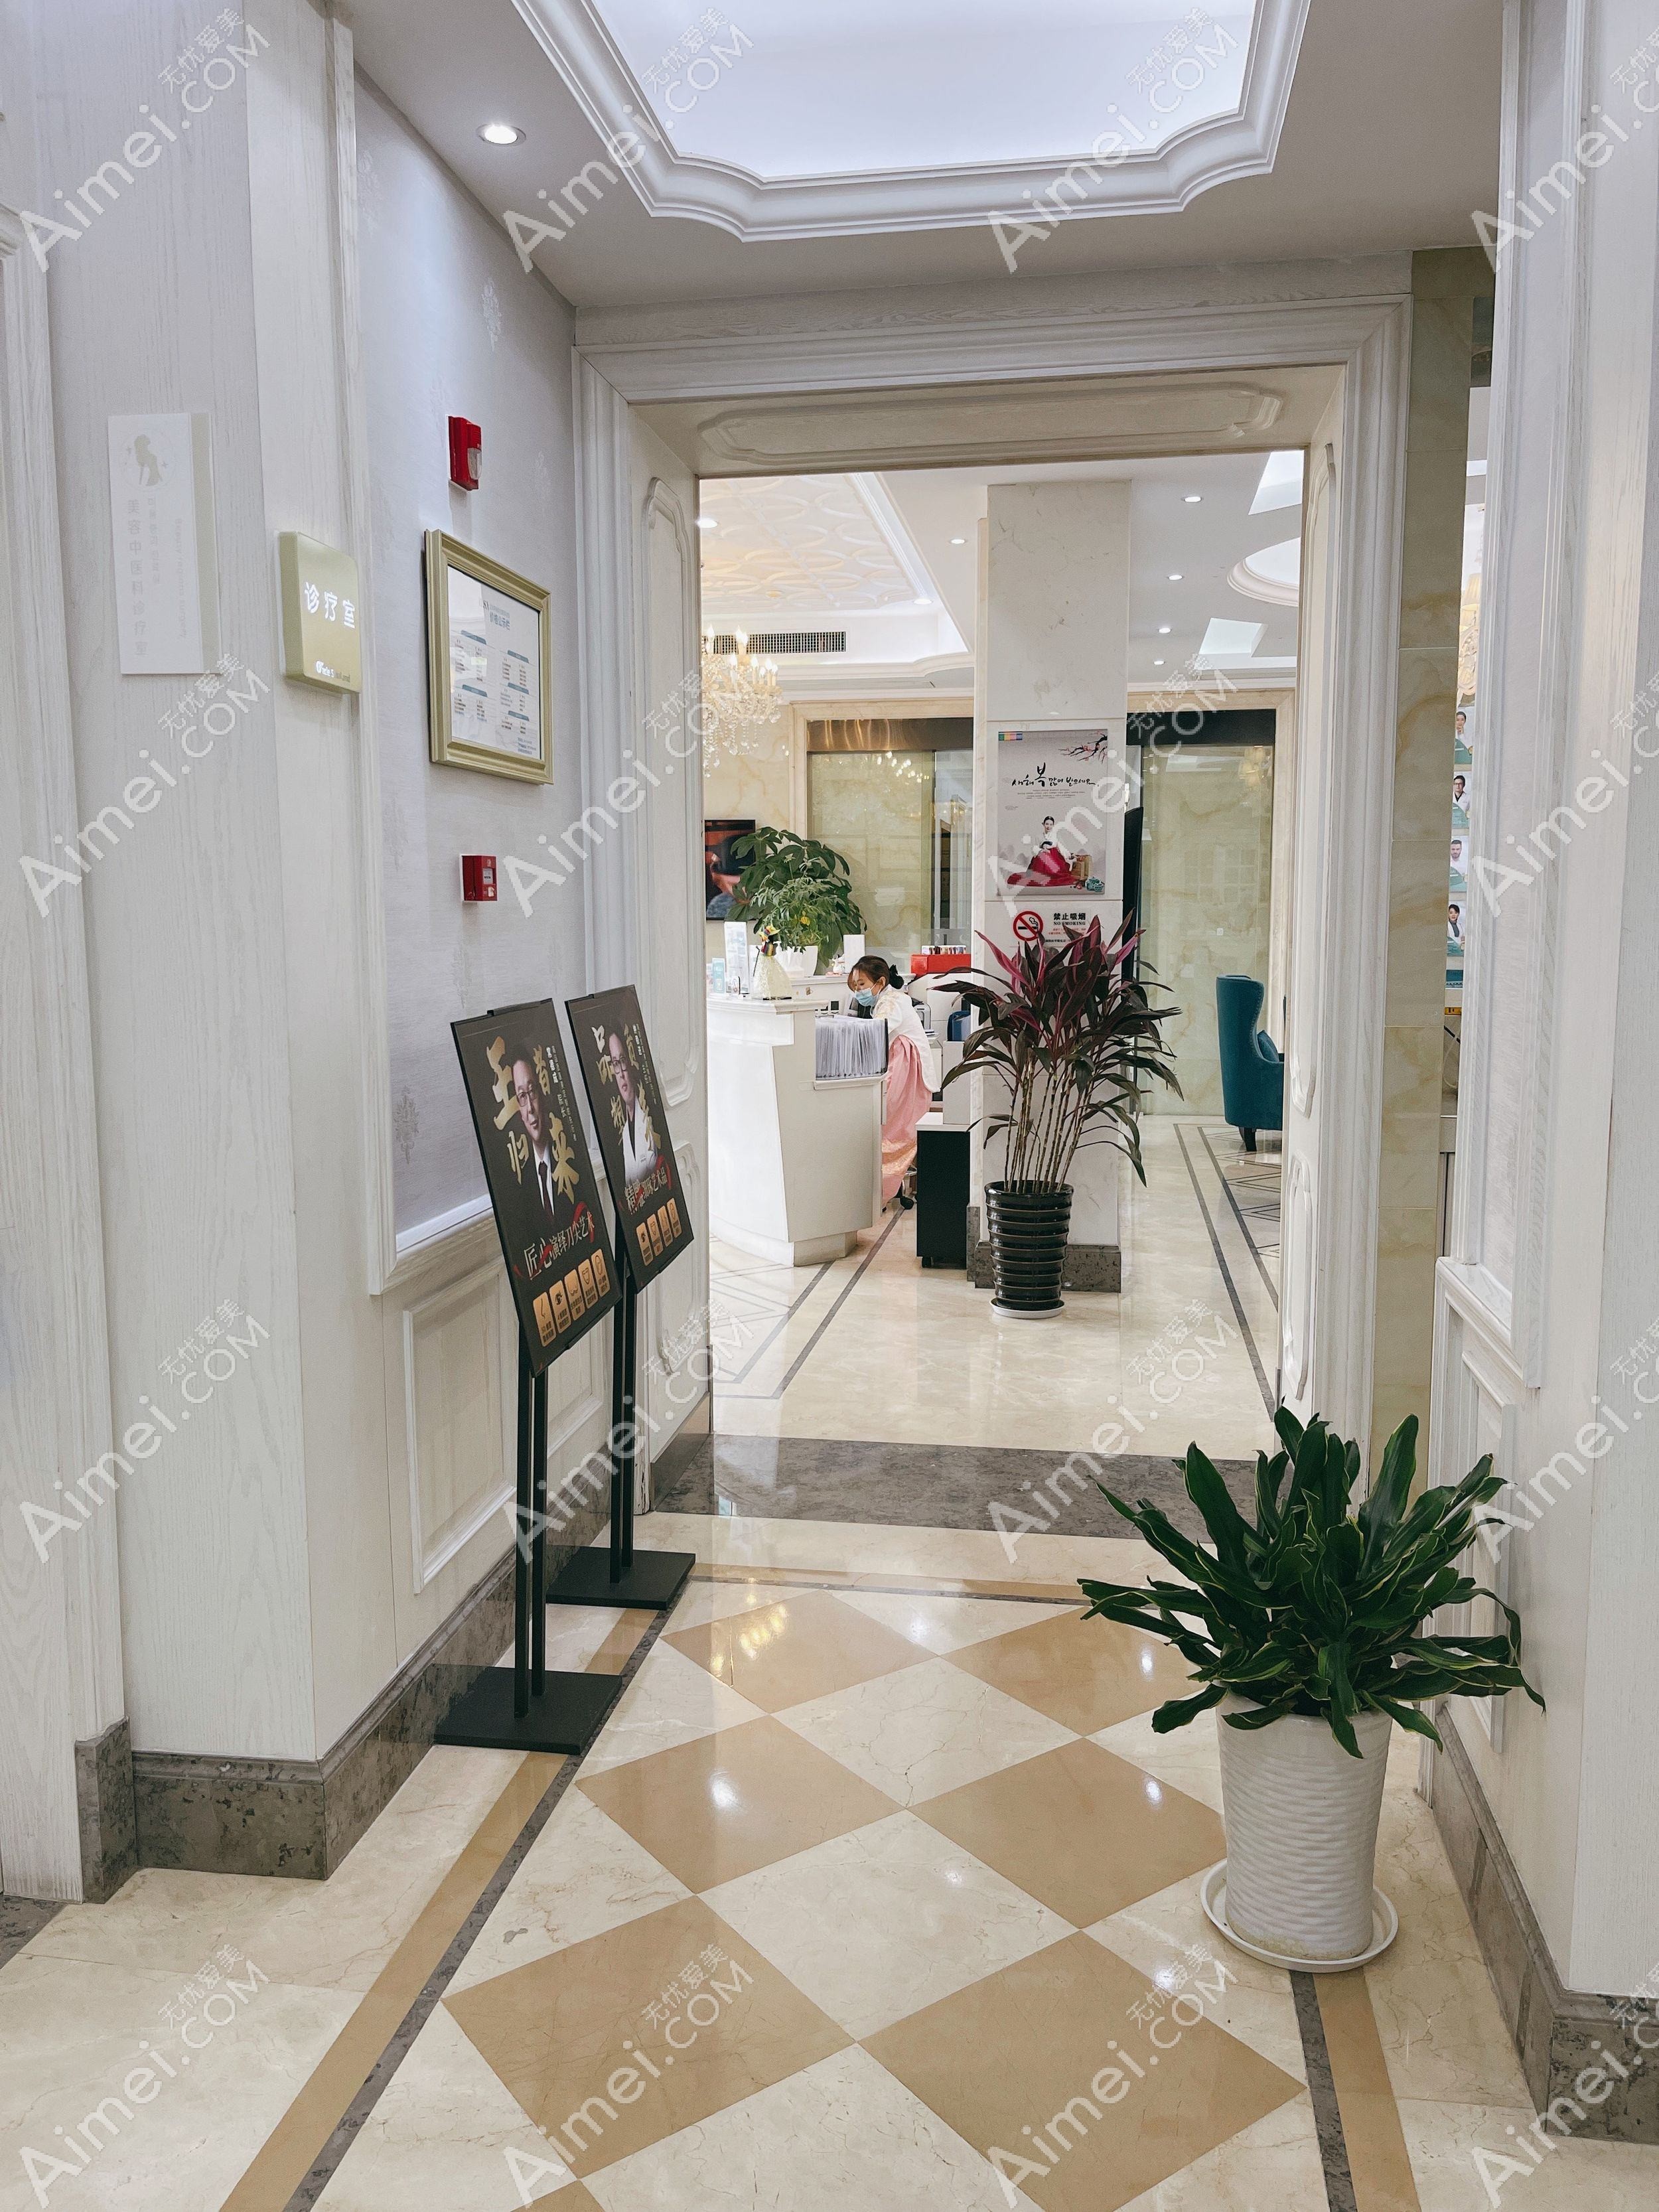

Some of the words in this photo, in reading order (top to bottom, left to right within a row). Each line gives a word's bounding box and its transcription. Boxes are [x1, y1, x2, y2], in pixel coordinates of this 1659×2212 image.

[305, 581, 356, 628] 诊疗室
[1035, 762, 1046, 787] 복
[524, 1211, 595, 1280] 匠心演绎刀尖艺术
